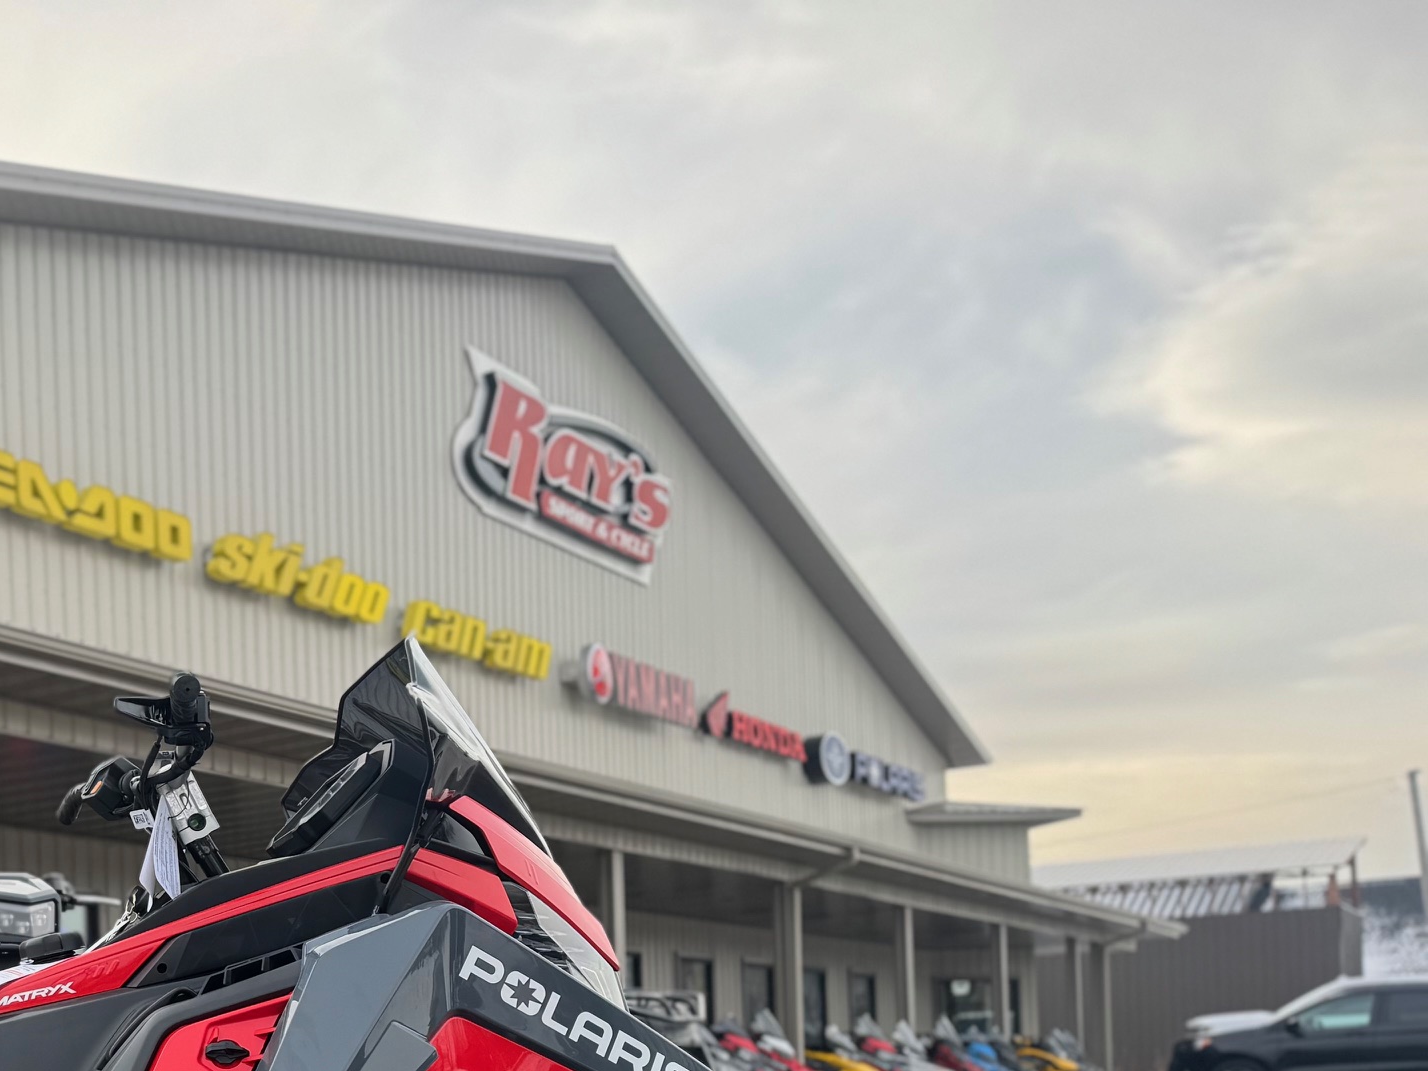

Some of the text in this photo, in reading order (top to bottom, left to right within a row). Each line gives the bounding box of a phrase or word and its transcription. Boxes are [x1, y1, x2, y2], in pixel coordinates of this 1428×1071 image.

[483, 377, 671, 531] Ray's
[610, 652, 698, 730] YAMAHA
[731, 710, 808, 764] HONDA
